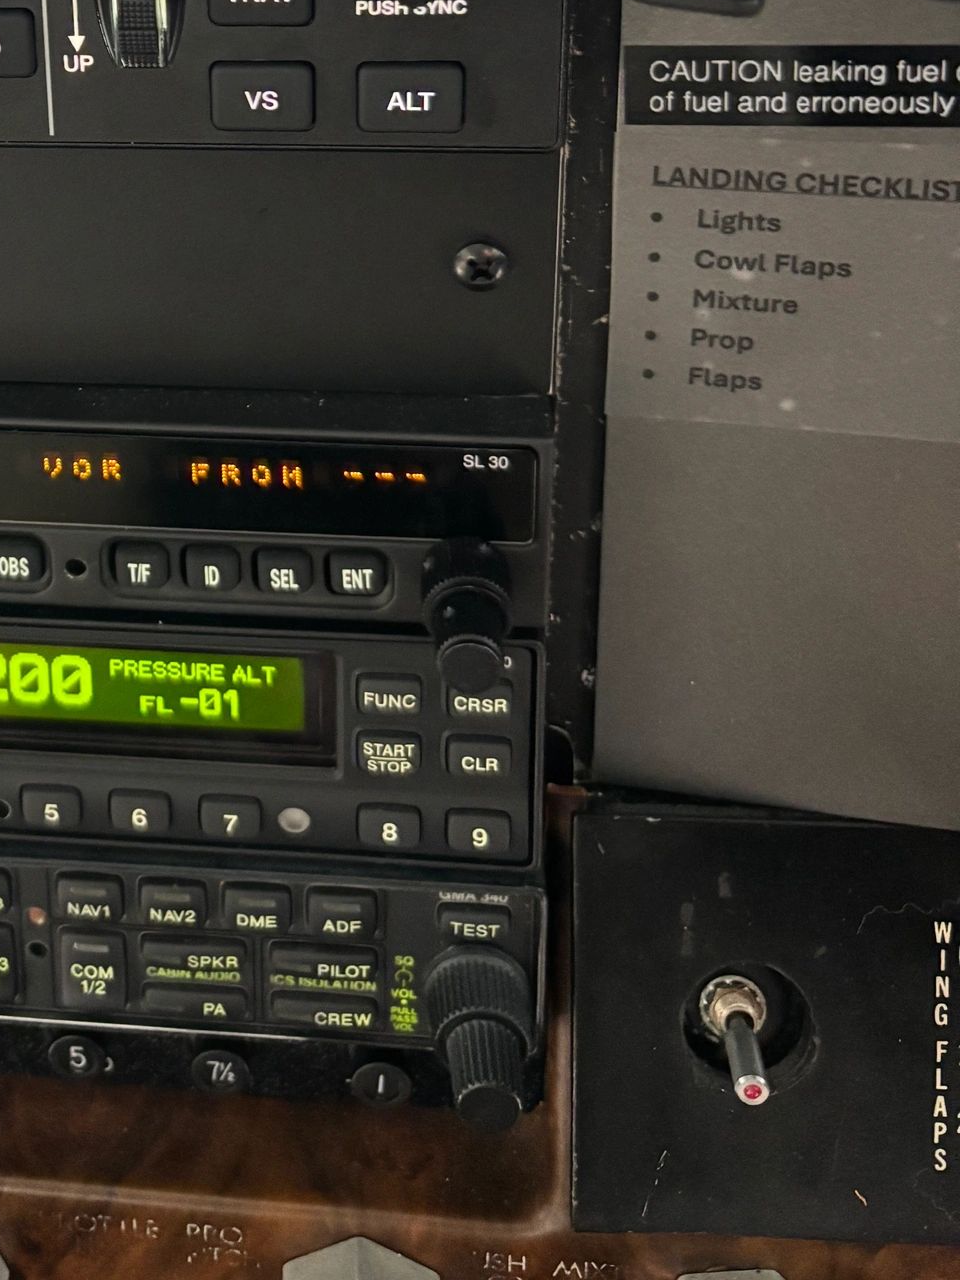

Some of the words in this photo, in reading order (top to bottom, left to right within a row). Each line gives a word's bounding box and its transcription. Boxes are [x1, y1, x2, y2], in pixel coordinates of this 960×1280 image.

[63, 55, 94, 72] UP
[649, 60, 783, 82] CAUTION
[793, 60, 887, 85] leaking
[897, 60, 947, 82] fuel
[244, 91, 279, 111] VS
[387, 92, 436, 111] ALT
[649, 91, 675, 113] of
[684, 91, 729, 113] fuel
[738, 92, 788, 113] and
[796, 91, 955, 118] erroneously
[652, 165, 788, 192] LANDING
[698, 209, 782, 234] Lights
[694, 249, 766, 272] Cowl
[774, 253, 852, 281] Flaps
[693, 288, 799, 315] Mixture
[690, 328, 754, 354] Prop
[688, 366, 762, 392] Flaps
[43, 456, 122, 480] VOR
[463, 454, 484, 469] SL
[488, 455, 509, 469] 30
[204, 565, 219, 586] ID
[270, 568, 299, 591] SEL
[342, 568, 373, 590] ENT
[109, 658, 225, 683] PRESSURE
[232, 664, 276, 685] ALT
[363, 692, 416, 709] FUNC
[454, 696, 508, 713] CRSR
[363, 742, 415, 757] START
[367, 760, 412, 773] STOP
[461, 757, 499, 772] CLR
[382, 822, 398, 842] 8
[472, 828, 488, 847] 9
[67, 902, 111, 918] NAV1
[150, 908, 196, 923] NAV2
[236, 914, 278, 928] DME
[323, 920, 362, 934] ADF
[450, 921, 501, 937] TEST
[187, 955, 239, 968] SPKR
[317, 964, 370, 978] PILOT
[70, 964, 114, 980] COM
[933, 921, 952, 1027] WING
[203, 1003, 226, 1016] PA
[314, 1012, 372, 1027] CREW
[933, 1040, 950, 1172] FLAPS
